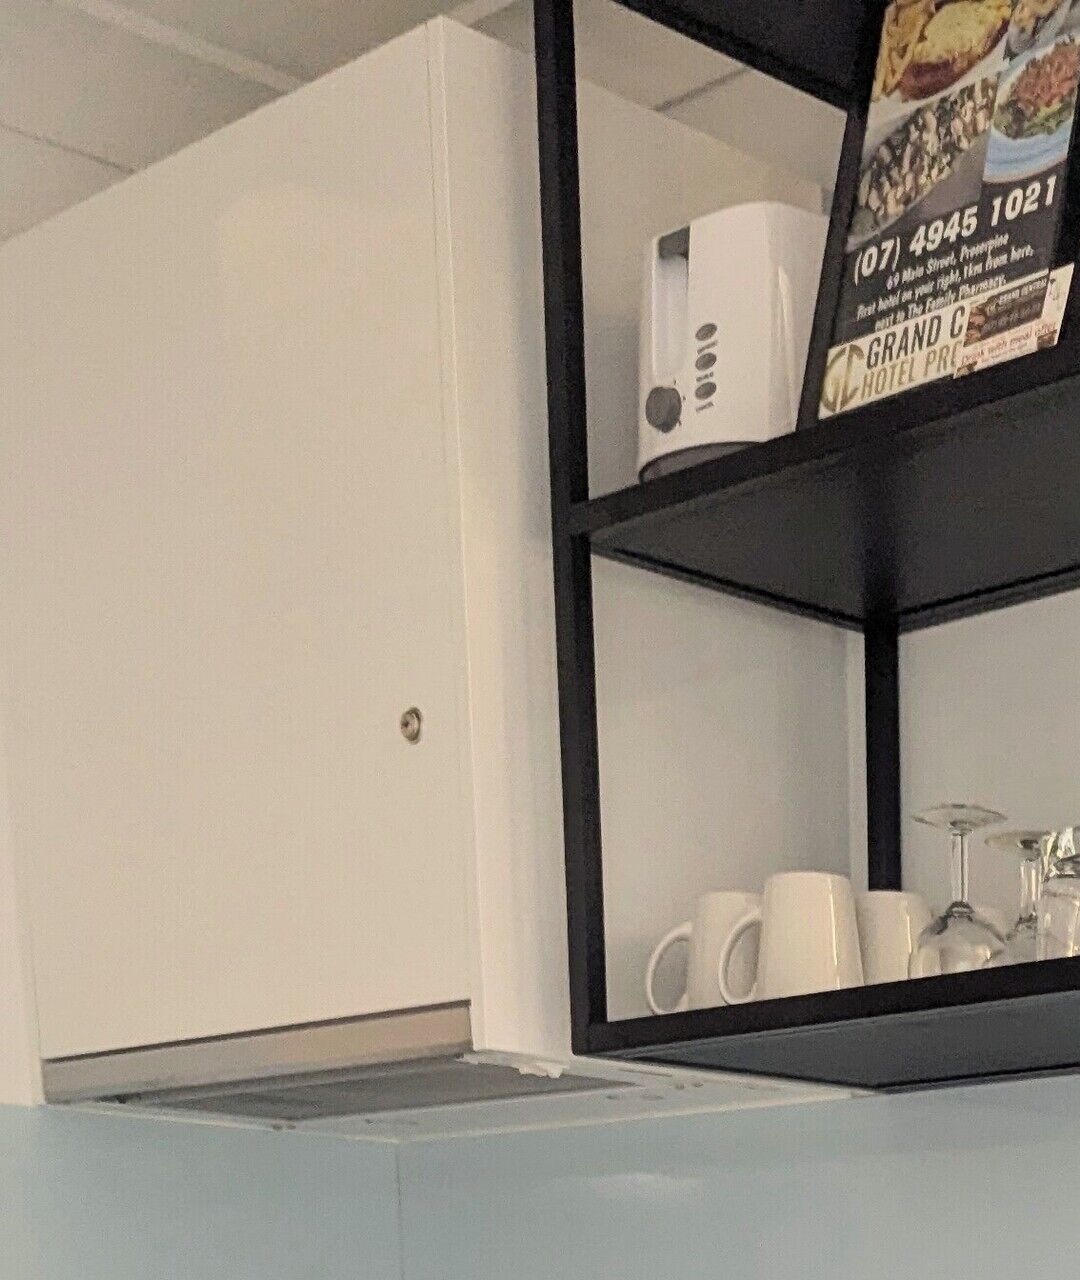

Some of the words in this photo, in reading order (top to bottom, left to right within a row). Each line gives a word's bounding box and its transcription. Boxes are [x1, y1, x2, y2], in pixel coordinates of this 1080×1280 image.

[854, 236, 901, 286] (07)
[909, 205, 978, 257] 4945
[991, 175, 1057, 226] 1021
[901, 266, 925, 284] Main
[926, 251, 957, 274] Street,
[959, 233, 1010, 262] Proserpine
[856, 302, 877, 320] First
[878, 292, 900, 309] hotel
[901, 289, 913, 301] on
[914, 282, 935, 301] your
[936, 270, 961, 291] right,
[984, 252, 1008, 271] from
[874, 317, 894, 331] next
[898, 311, 906, 322] to
[907, 303, 924, 318] The
[925, 292, 956, 314] Family
[866, 315, 942, 370] GRAND
[860, 356, 916, 401] HOTEL
